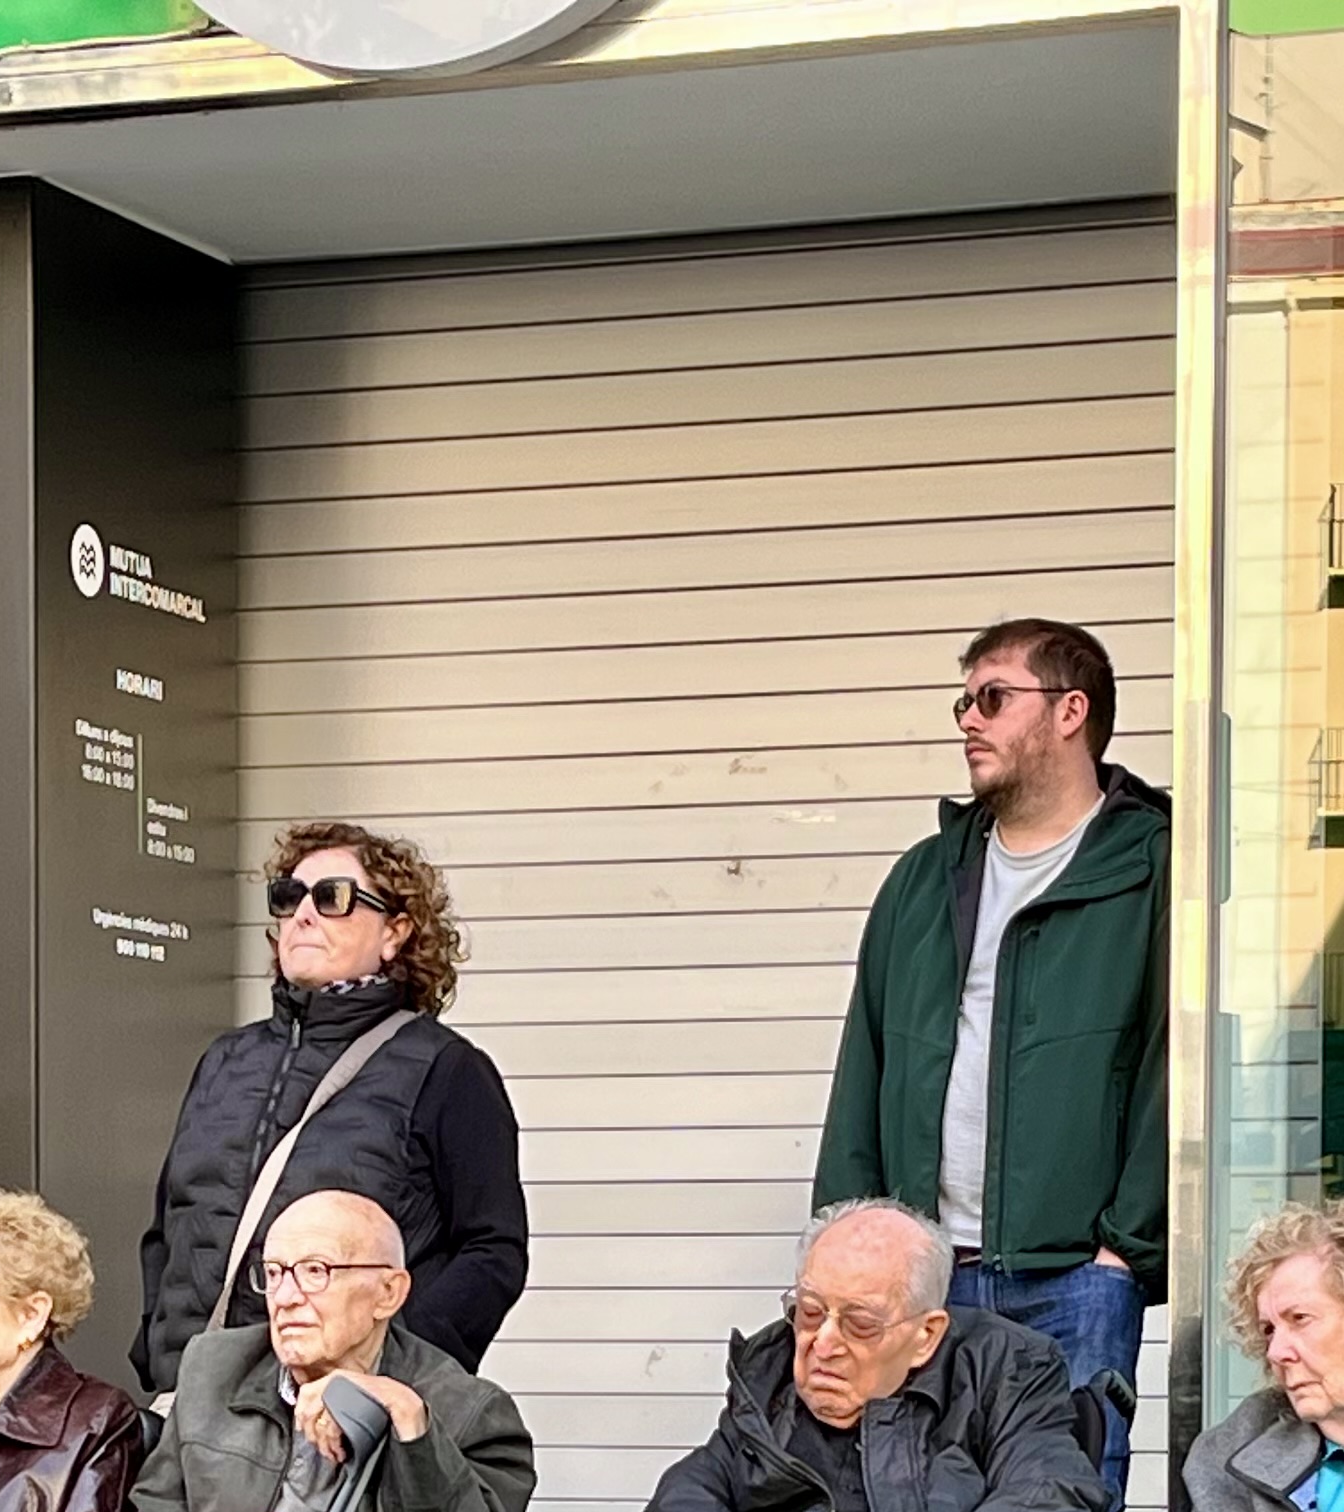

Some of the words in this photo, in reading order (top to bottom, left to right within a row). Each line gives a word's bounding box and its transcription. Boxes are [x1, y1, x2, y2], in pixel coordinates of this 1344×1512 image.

[109, 545, 153, 578] MUTUA
[109, 572, 206, 623] INTERCOMARCAL
[116, 669, 163, 700] HORARI
